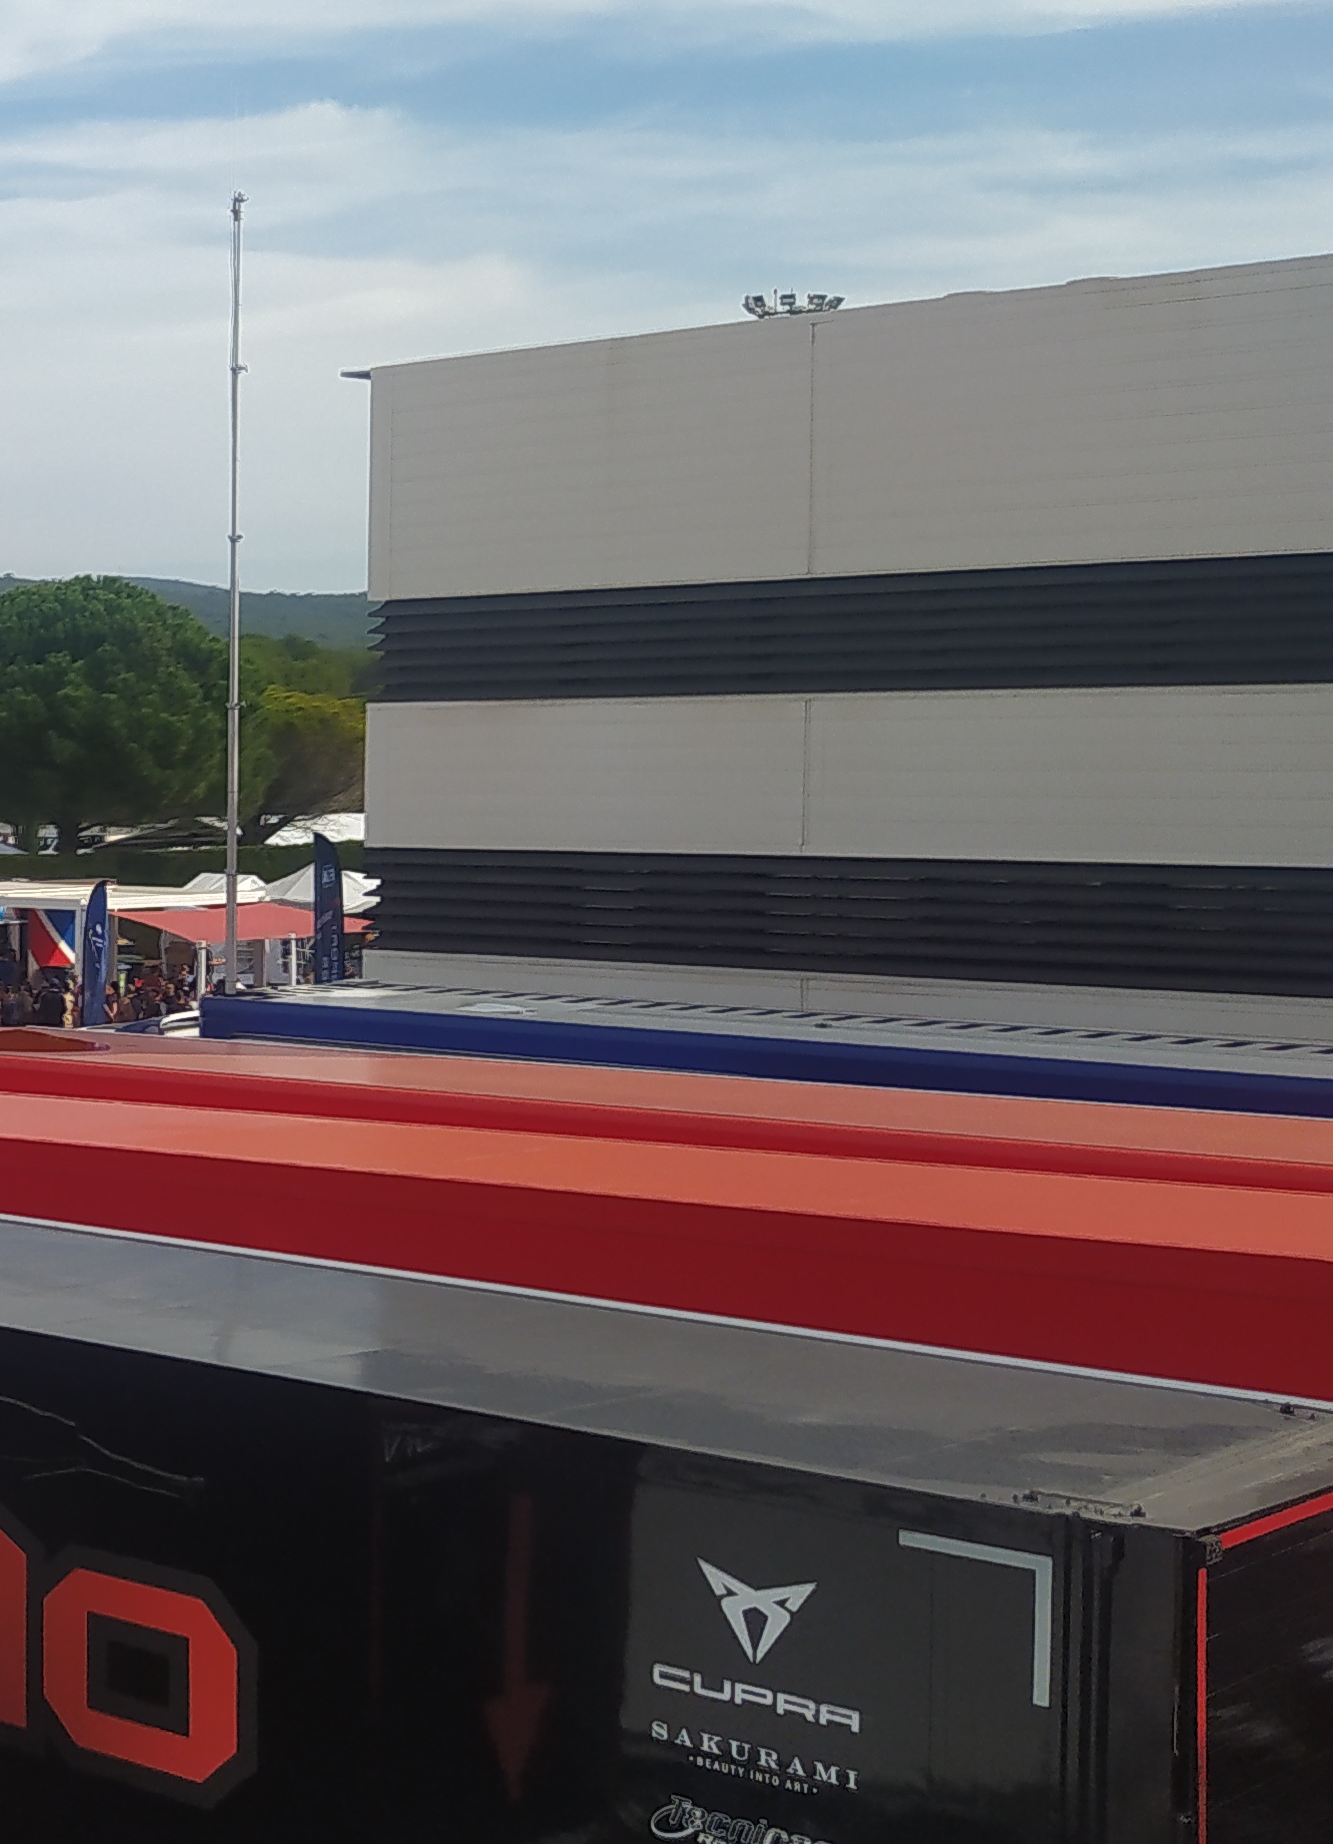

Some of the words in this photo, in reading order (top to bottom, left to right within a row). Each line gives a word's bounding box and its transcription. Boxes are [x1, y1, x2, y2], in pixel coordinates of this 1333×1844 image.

[652, 1662, 862, 1734] CUPRA
[650, 1720, 860, 1791] SAKURAMI
[695, 1756, 745, 1779] BEAUTY
[749, 1770, 780, 1788] INTO
[784, 1779, 809, 1795] ART
